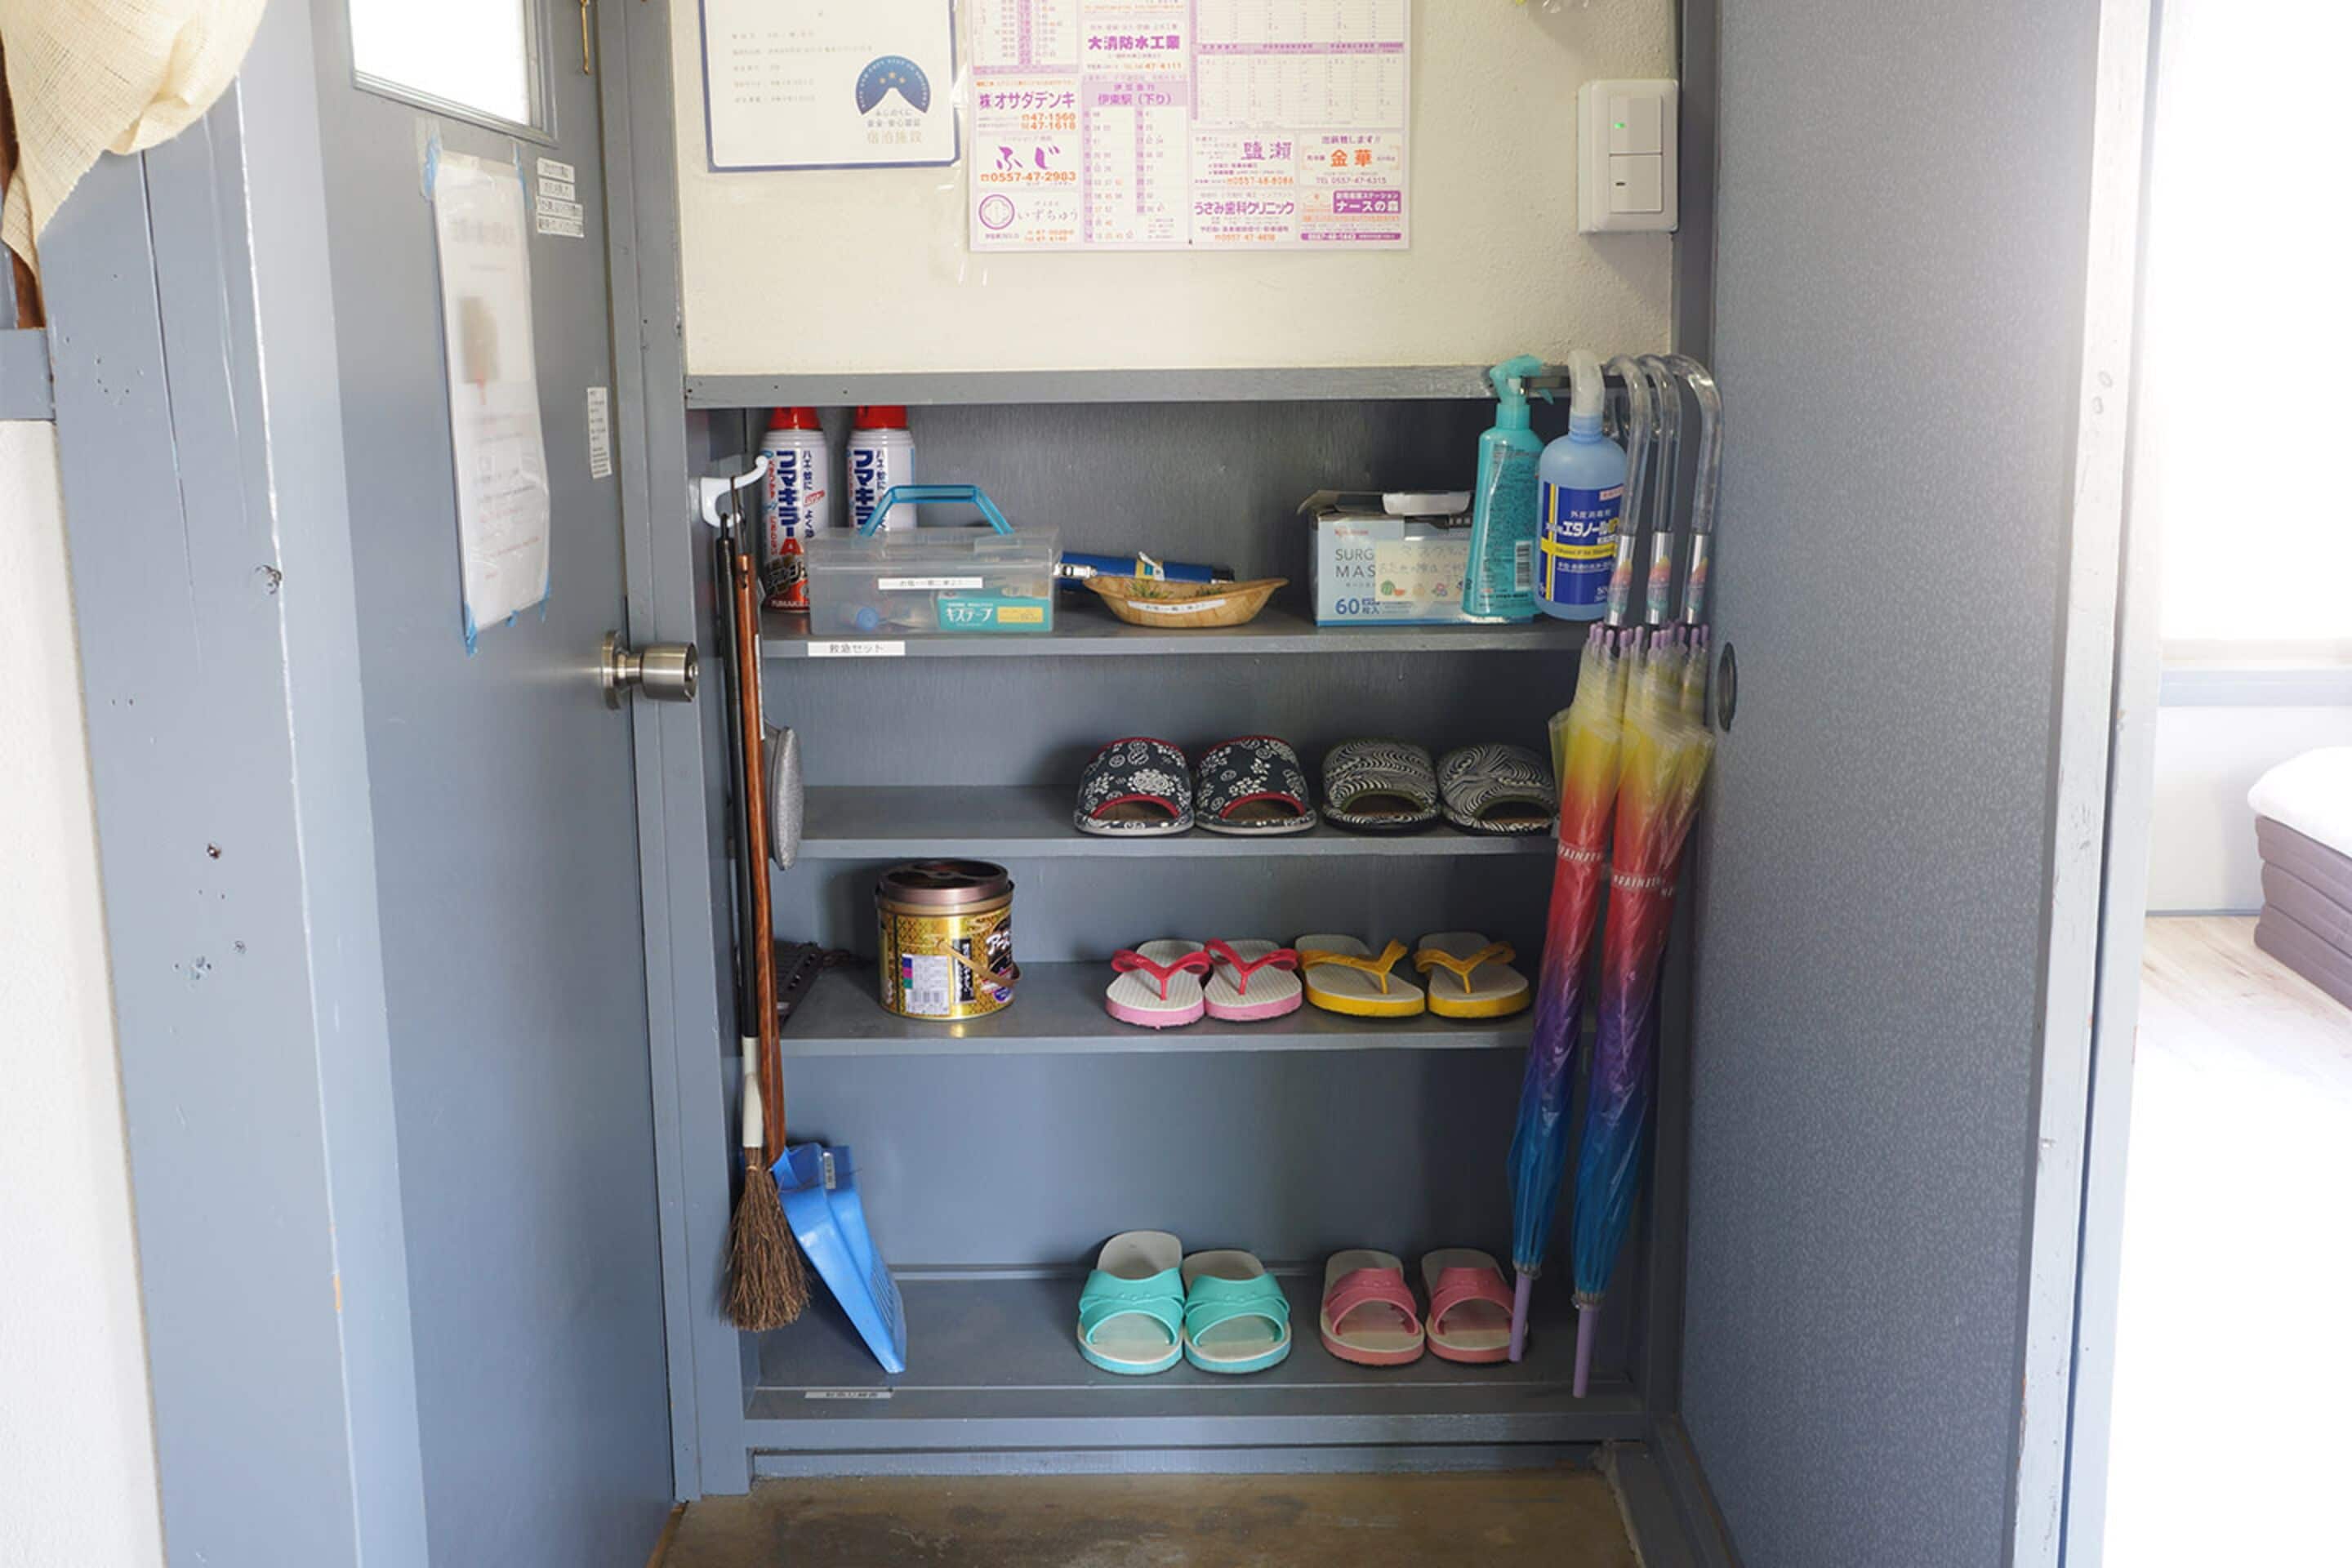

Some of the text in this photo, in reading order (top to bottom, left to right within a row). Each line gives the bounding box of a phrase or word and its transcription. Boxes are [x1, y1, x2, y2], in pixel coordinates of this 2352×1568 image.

[996, 145, 1060, 172] ふじ
[1330, 149, 1373, 167] 金華
[1335, 548, 1374, 562] SURG
[1336, 564, 1376, 578] MAS
[1335, 598, 1360, 615] 60
